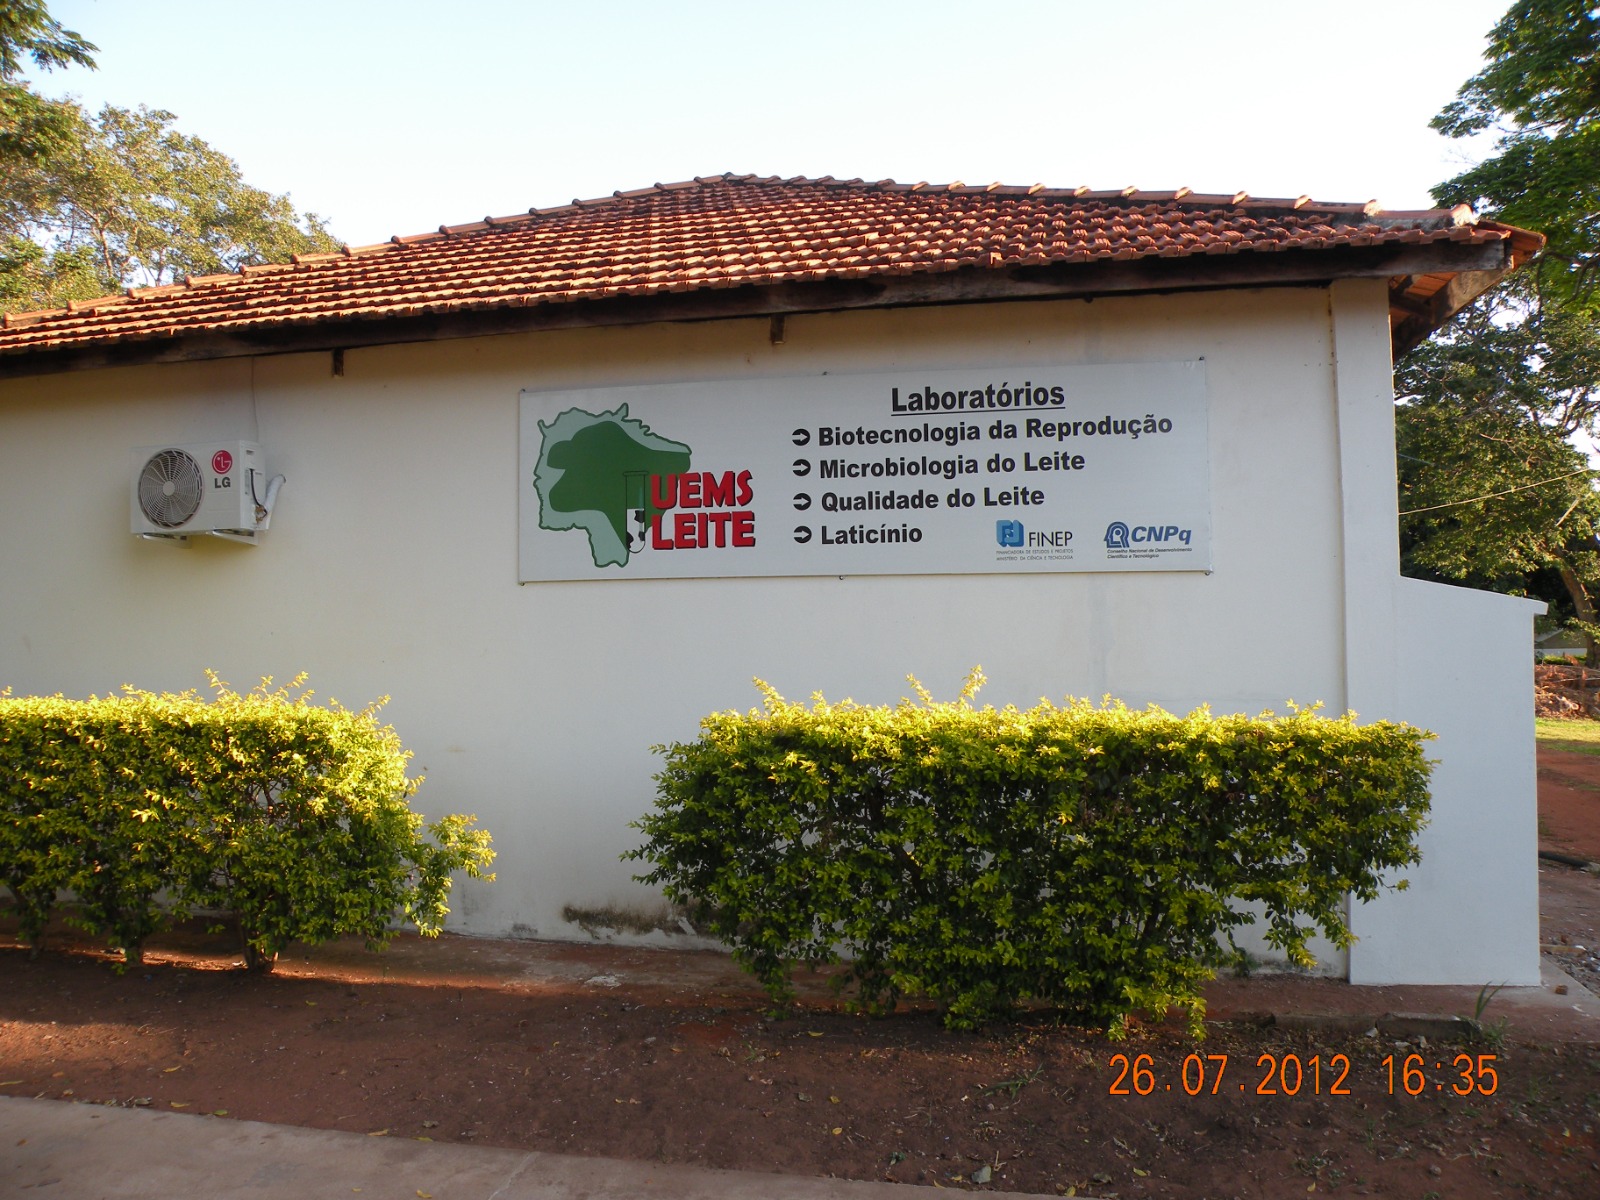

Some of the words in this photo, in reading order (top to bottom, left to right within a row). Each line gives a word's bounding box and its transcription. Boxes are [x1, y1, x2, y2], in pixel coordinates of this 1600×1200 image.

[892, 381, 1065, 412] Laboratórios
[819, 422, 981, 446] Biotecnologia
[989, 420, 1018, 440] da
[1026, 414, 1173, 442] Reprodução
[820, 455, 979, 479] Microbiologia
[987, 453, 1016, 473] do
[1024, 451, 1085, 472] Leite
[214, 477, 231, 488] LG
[651, 469, 754, 510] UEMS
[821, 489, 939, 513] Qualidade
[947, 488, 976, 508] do
[984, 486, 1045, 507] Leite
[651, 511, 756, 550] LEITE
[821, 523, 923, 545] Laticínio
[1028, 531, 1073, 547] FINEP
[1131, 526, 1192, 545] CNPq
